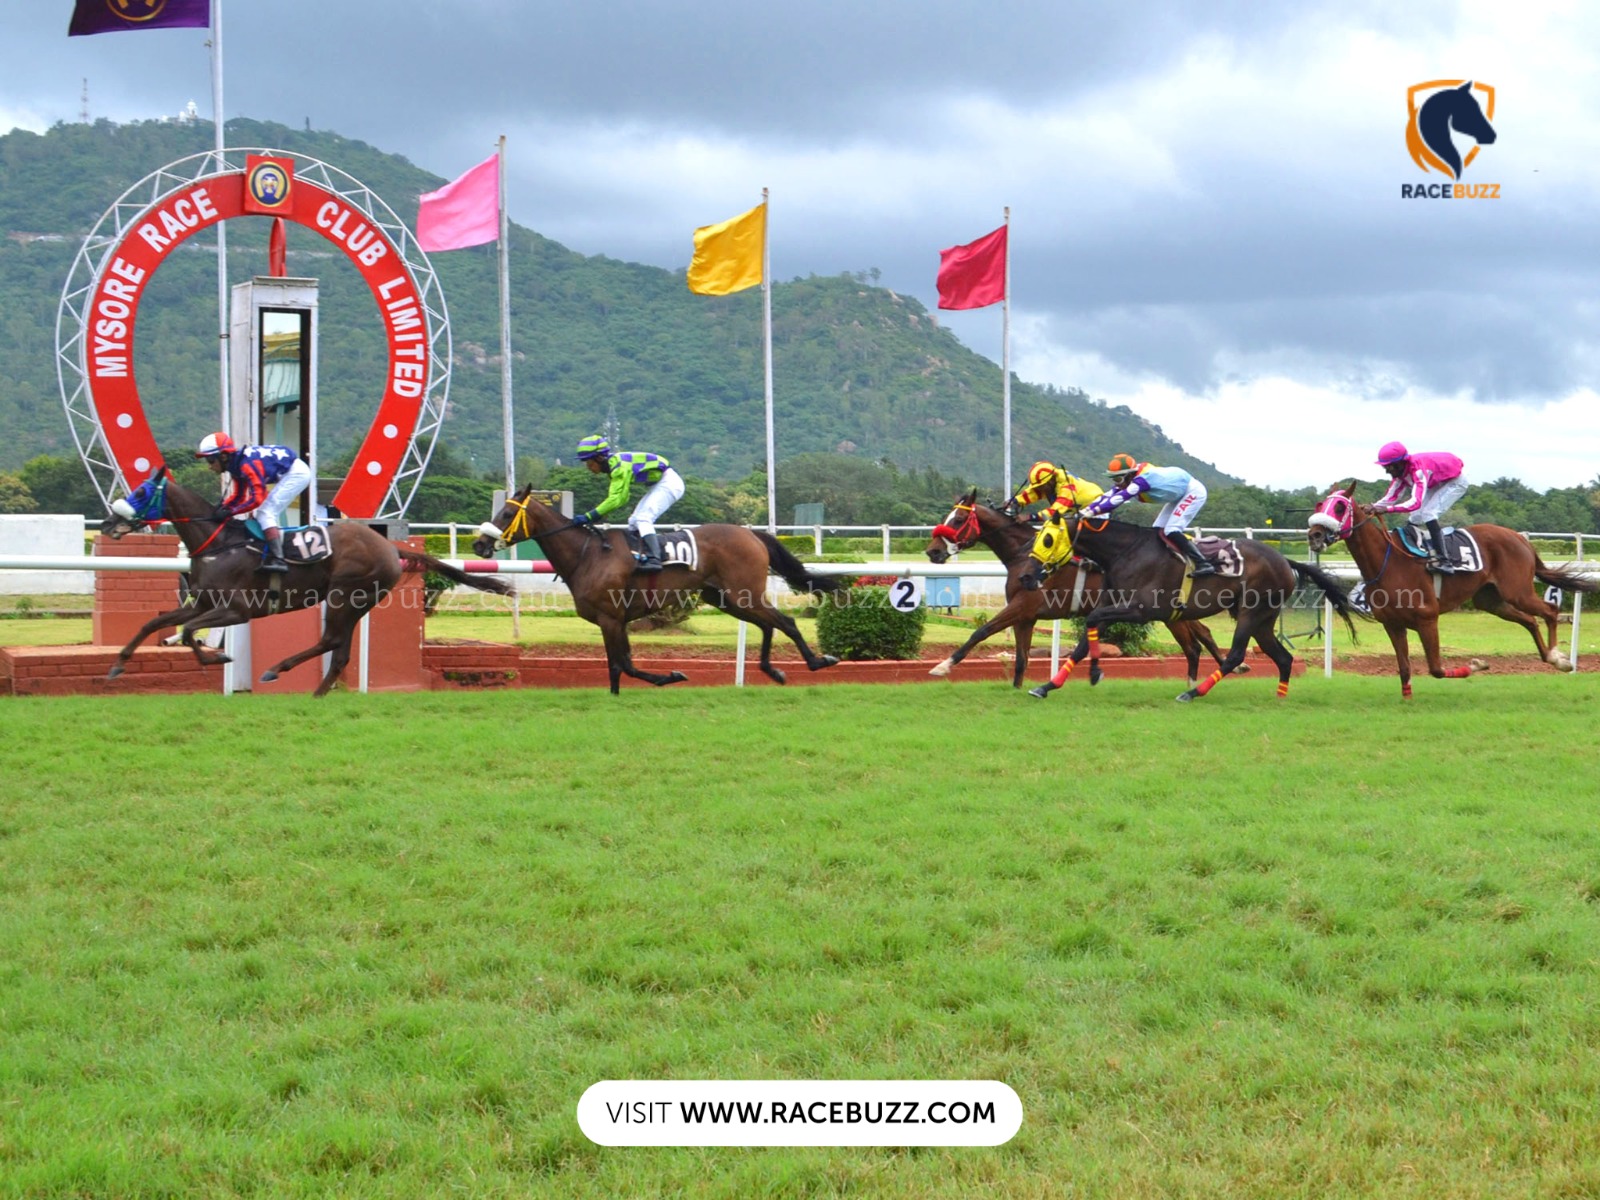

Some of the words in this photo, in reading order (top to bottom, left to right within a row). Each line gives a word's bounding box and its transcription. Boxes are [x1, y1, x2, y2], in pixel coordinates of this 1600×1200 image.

[95, 257, 145, 378] MYSORE
[138, 188, 218, 253] RACE
[316, 201, 388, 267] CLUB
[378, 276, 424, 398] LIMITED
[292, 530, 326, 559] 12
[664, 540, 693, 563] 10
[1459, 546, 1477, 571] 5
[896, 581, 915, 608] 2
[1549, 587, 1559, 605] 5
